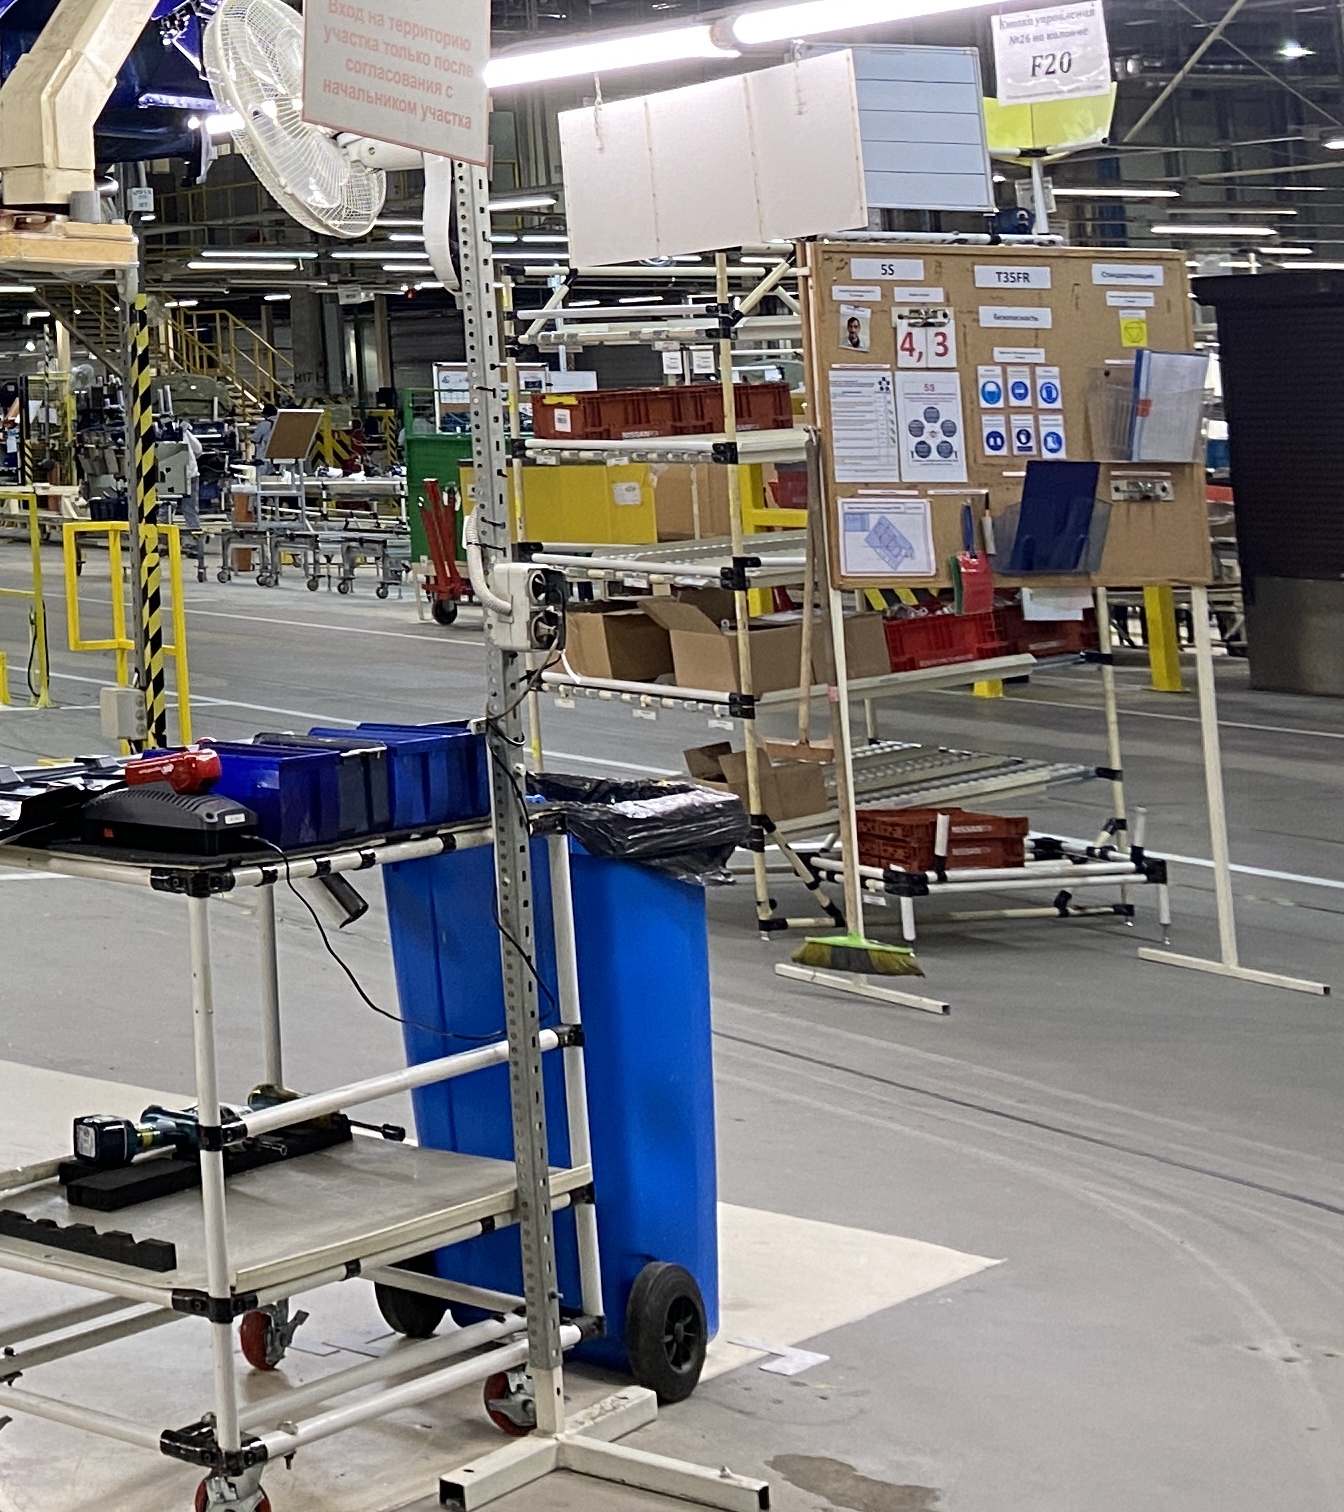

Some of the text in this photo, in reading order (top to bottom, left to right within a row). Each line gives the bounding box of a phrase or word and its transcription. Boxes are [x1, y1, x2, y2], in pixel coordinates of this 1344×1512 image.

[323, 24, 475, 78] участка только после
[368, 11, 385, 27] на
[387, 16, 472, 52] территорию
[345, 58, 454, 99] согласования с
[1030, 51, 1072, 78] F20
[323, 78, 472, 130] начальником участка
[880, 263, 895, 276] 5S
[995, 271, 1031, 283] T35FR
